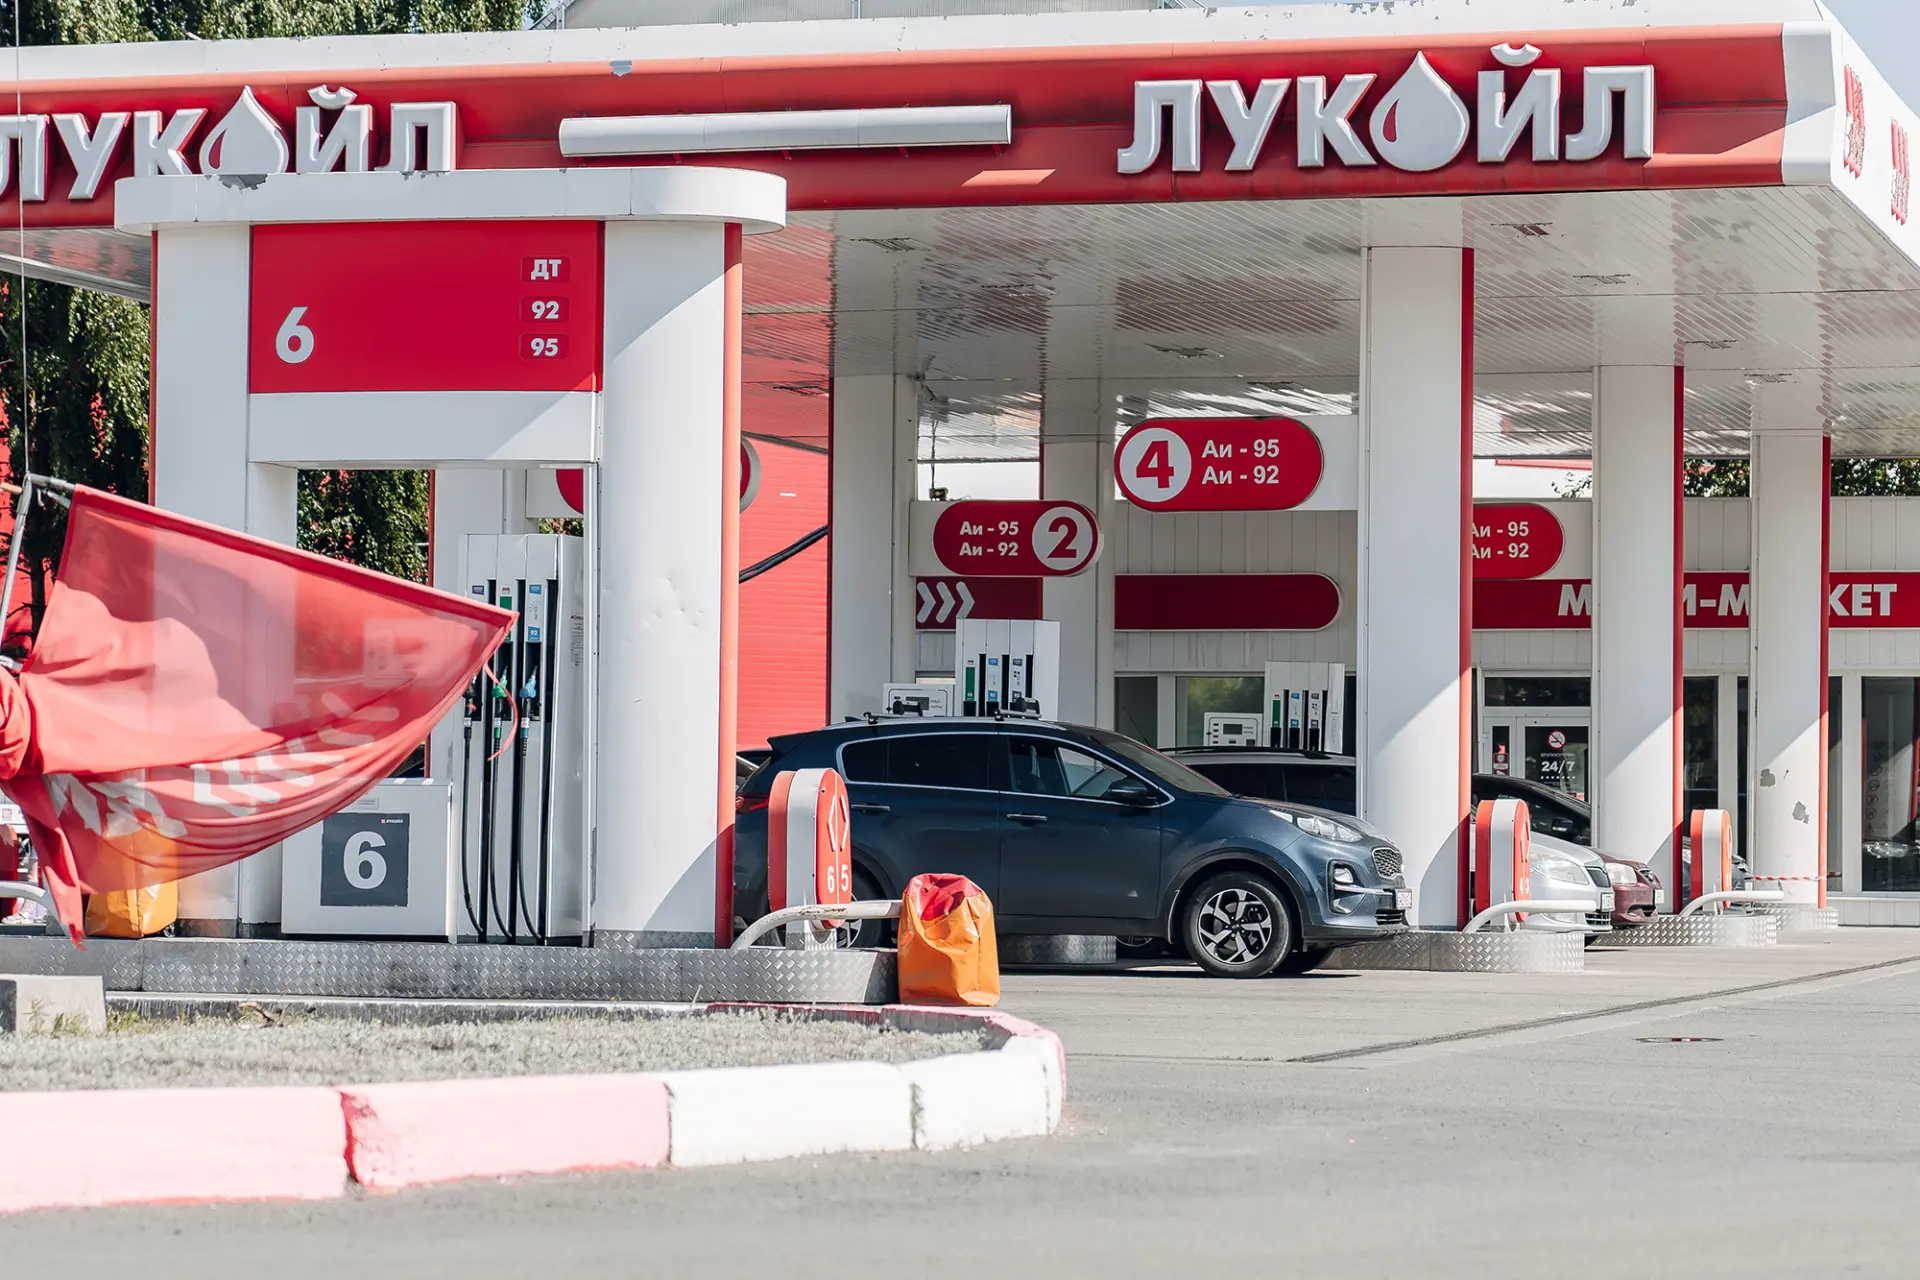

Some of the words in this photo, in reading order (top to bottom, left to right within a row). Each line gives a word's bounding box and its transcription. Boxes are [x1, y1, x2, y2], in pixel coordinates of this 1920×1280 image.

[530, 259, 562, 281] ДТ
[531, 300, 560, 320] 92
[275, 306, 315, 364] 6
[530, 337, 559, 357] 95
[1201, 438, 1232, 458] Аи
[1253, 438, 1280, 458] 95
[1135, 440, 1175, 489] 4
[1201, 465, 1232, 485] Аи
[1253, 465, 1280, 485] 92
[959, 521, 983, 536] Аи
[998, 521, 1019, 536] 95
[1047, 517, 1078, 559] 2
[1507, 521, 1529, 537] 95
[959, 542, 983, 557] Аи
[998, 542, 1019, 557] 92
[1508, 542, 1529, 558] 92
[1541, 760, 1576, 774] 24/7
[343, 830, 387, 890] 6
[827, 865, 835, 894] 6
[841, 864, 849, 892] 5
